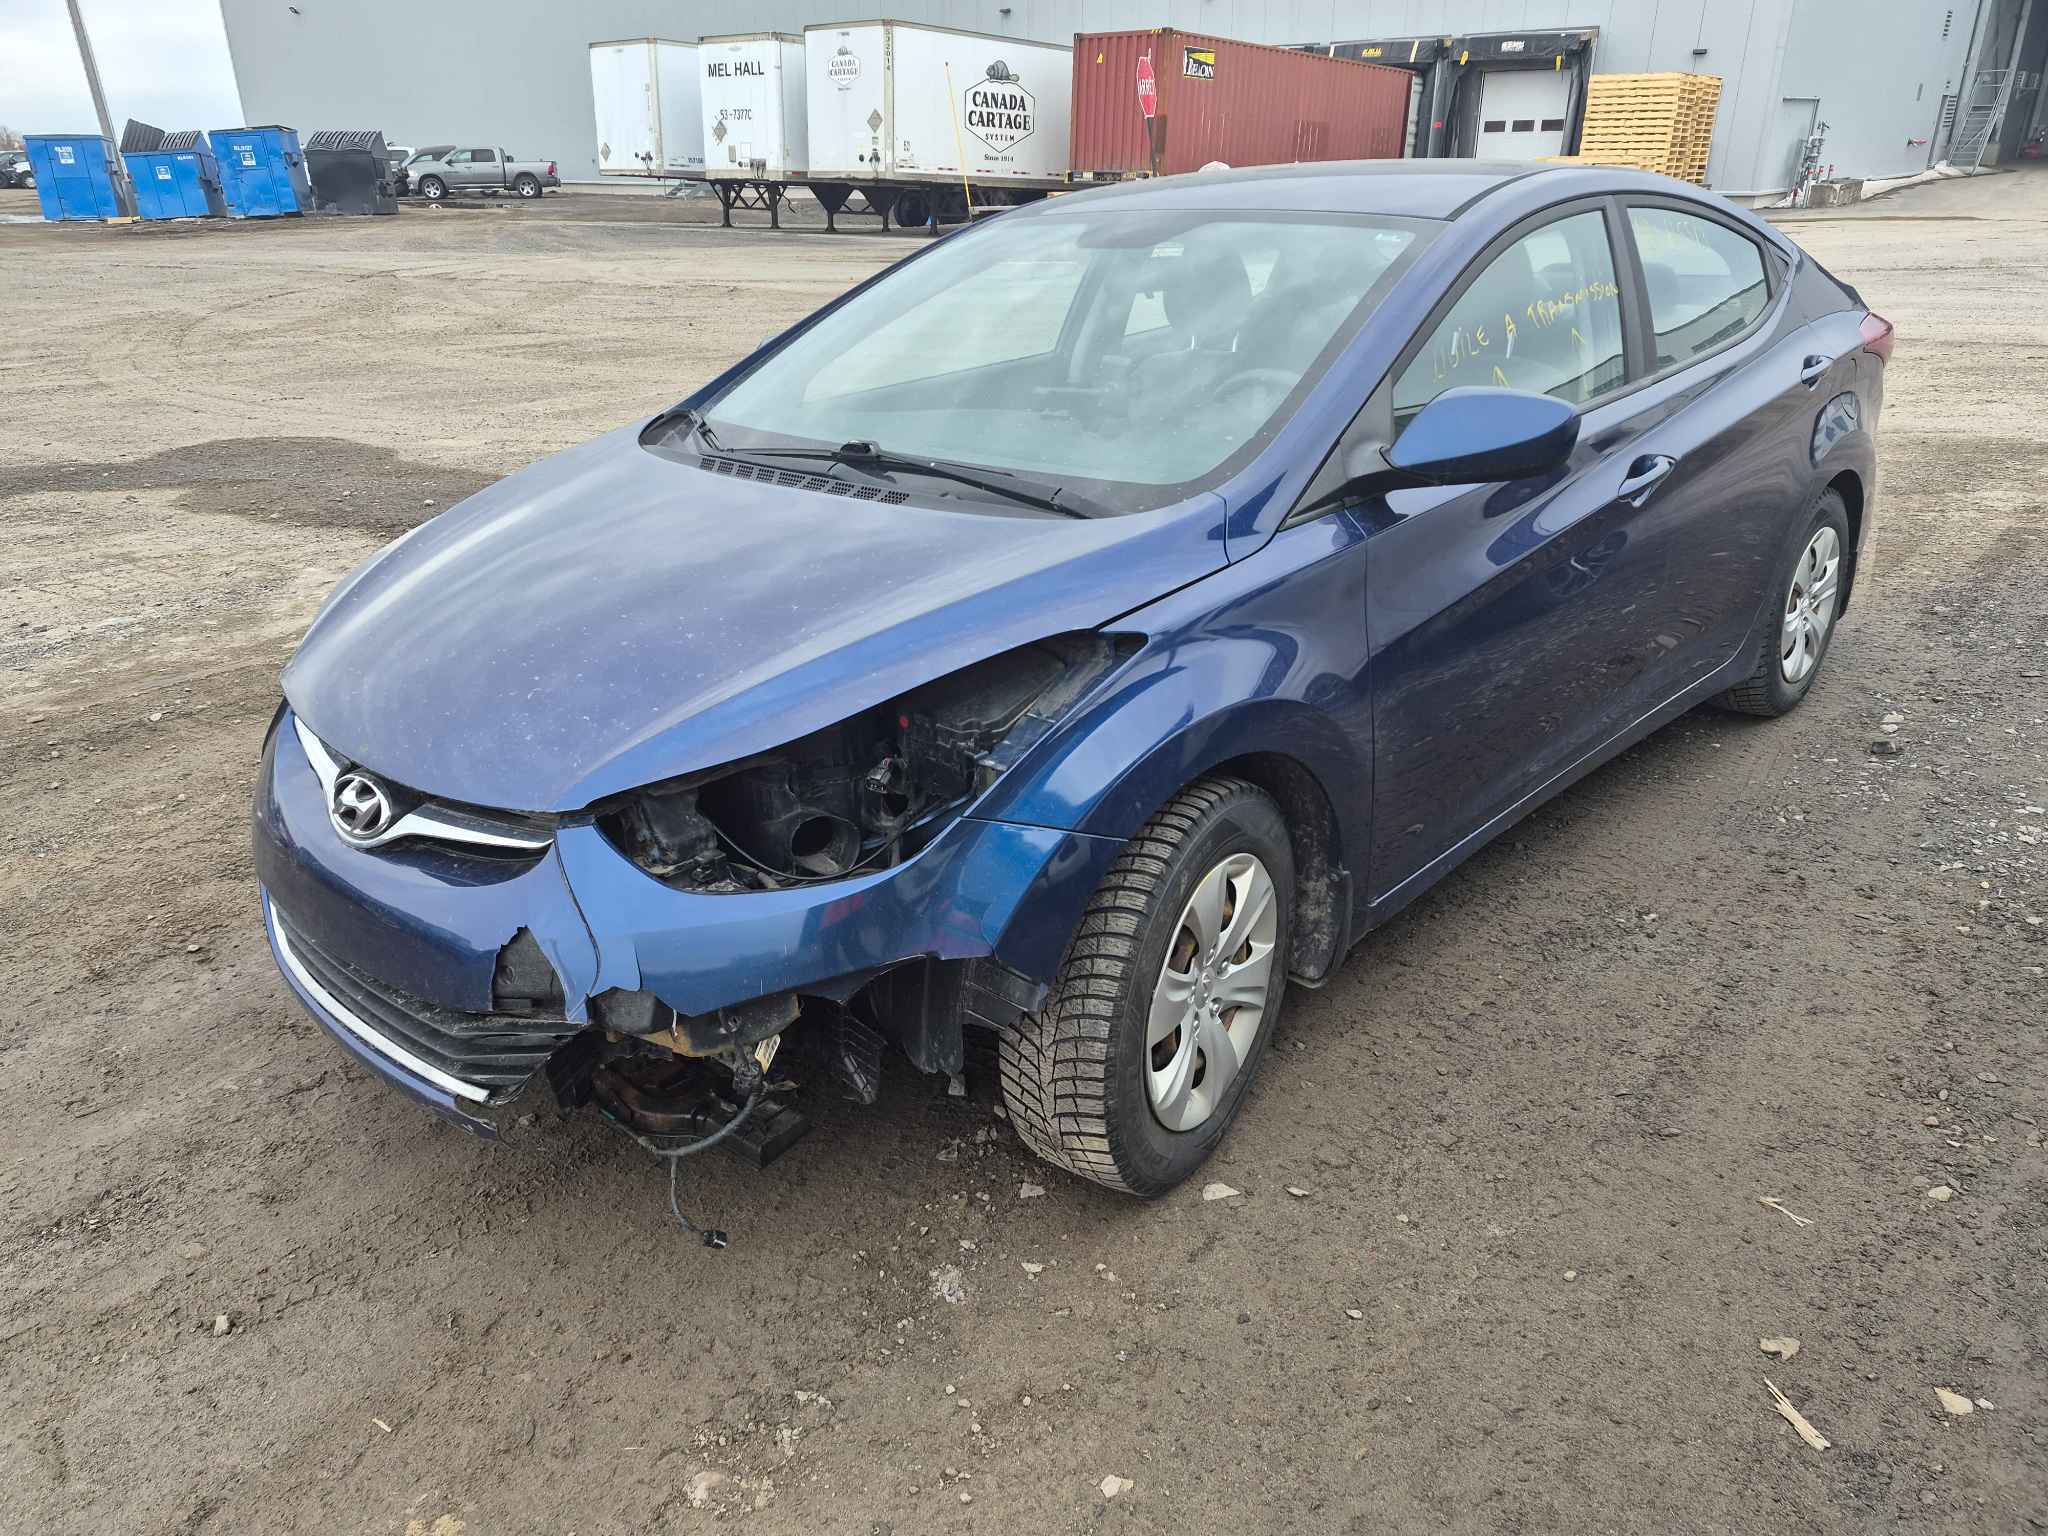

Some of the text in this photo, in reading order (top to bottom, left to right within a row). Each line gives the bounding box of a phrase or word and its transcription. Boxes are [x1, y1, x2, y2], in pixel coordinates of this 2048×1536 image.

[708, 61, 765, 78] MEL HALL
[972, 91, 1026, 111] CANADA
[720, 109, 753, 121] 53-7377C
[968, 110, 1031, 131] CARTAGE
[985, 133, 1015, 142] SYSTEM
